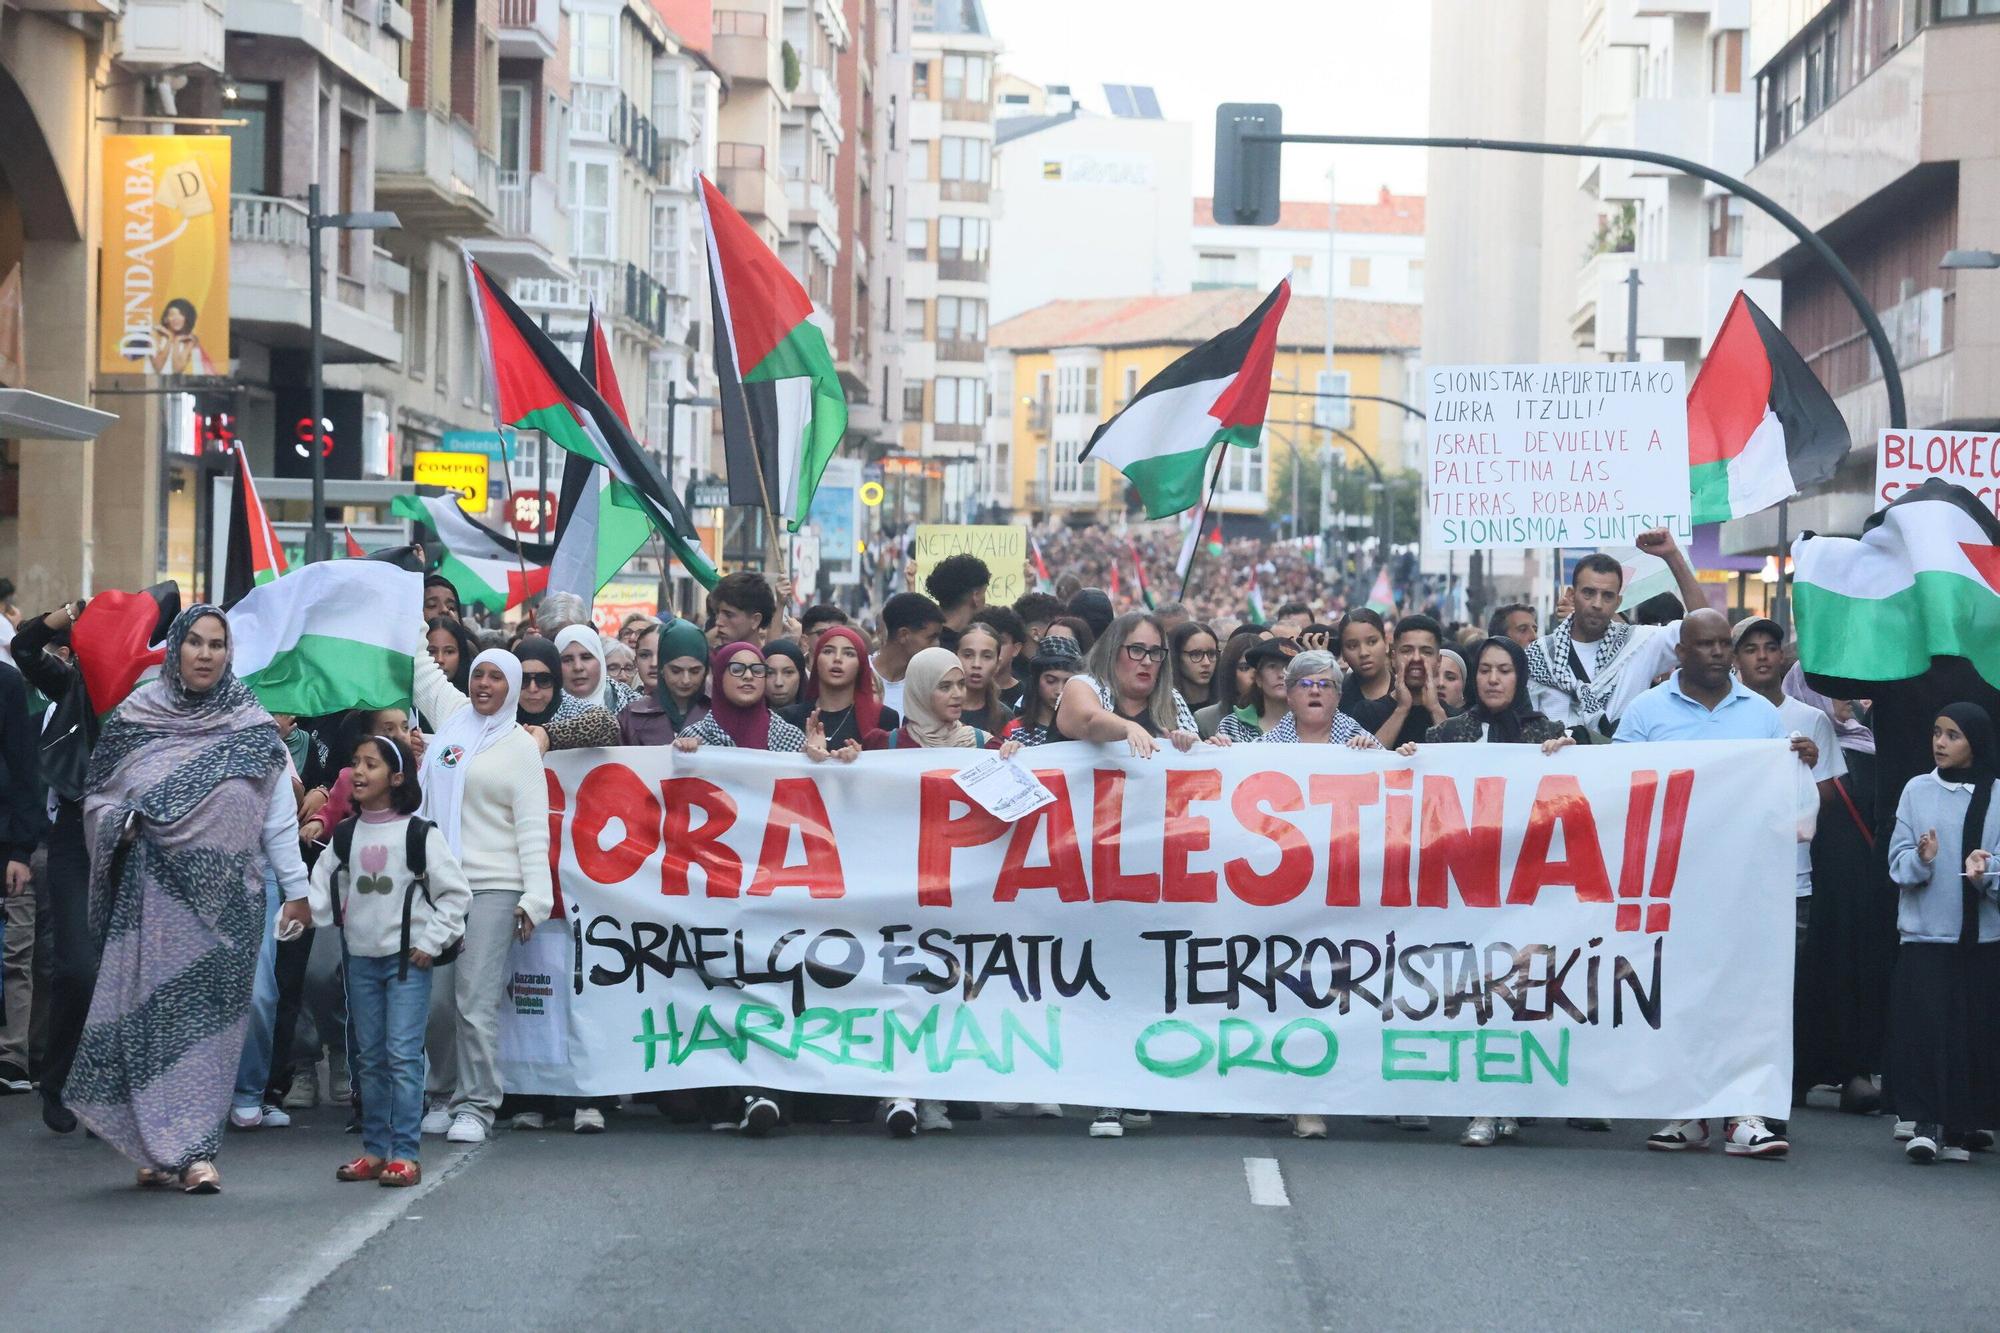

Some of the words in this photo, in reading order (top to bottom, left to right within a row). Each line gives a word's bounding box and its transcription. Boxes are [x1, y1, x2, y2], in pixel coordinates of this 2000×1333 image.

[177, 171, 200, 197] D
[119, 153, 157, 358] DENDARABA
[1434, 400, 1495, 422] LURRA
[1516, 397, 1605, 420] ITZULI!
[1435, 433, 1503, 455] ISRAEL
[1525, 430, 1629, 453] DEVUELVE
[1647, 429, 1662, 451] A
[418, 463, 485, 474] COMPRO
[1434, 460, 1554, 484] PALESTINA
[1570, 460, 1610, 482] LAS
[1432, 491, 1515, 516] TIERRAS
[1532, 490, 1625, 514] ROBADAS
[1443, 517, 1569, 543] SIONISMOA
[545, 763, 846, 918] ORA
[878, 924, 1111, 1002] ESTATU
[632, 1002, 1063, 1072] HARREMAN
[1135, 1017, 1338, 1077] ORO
[1381, 1027, 1570, 1086] ETEN
